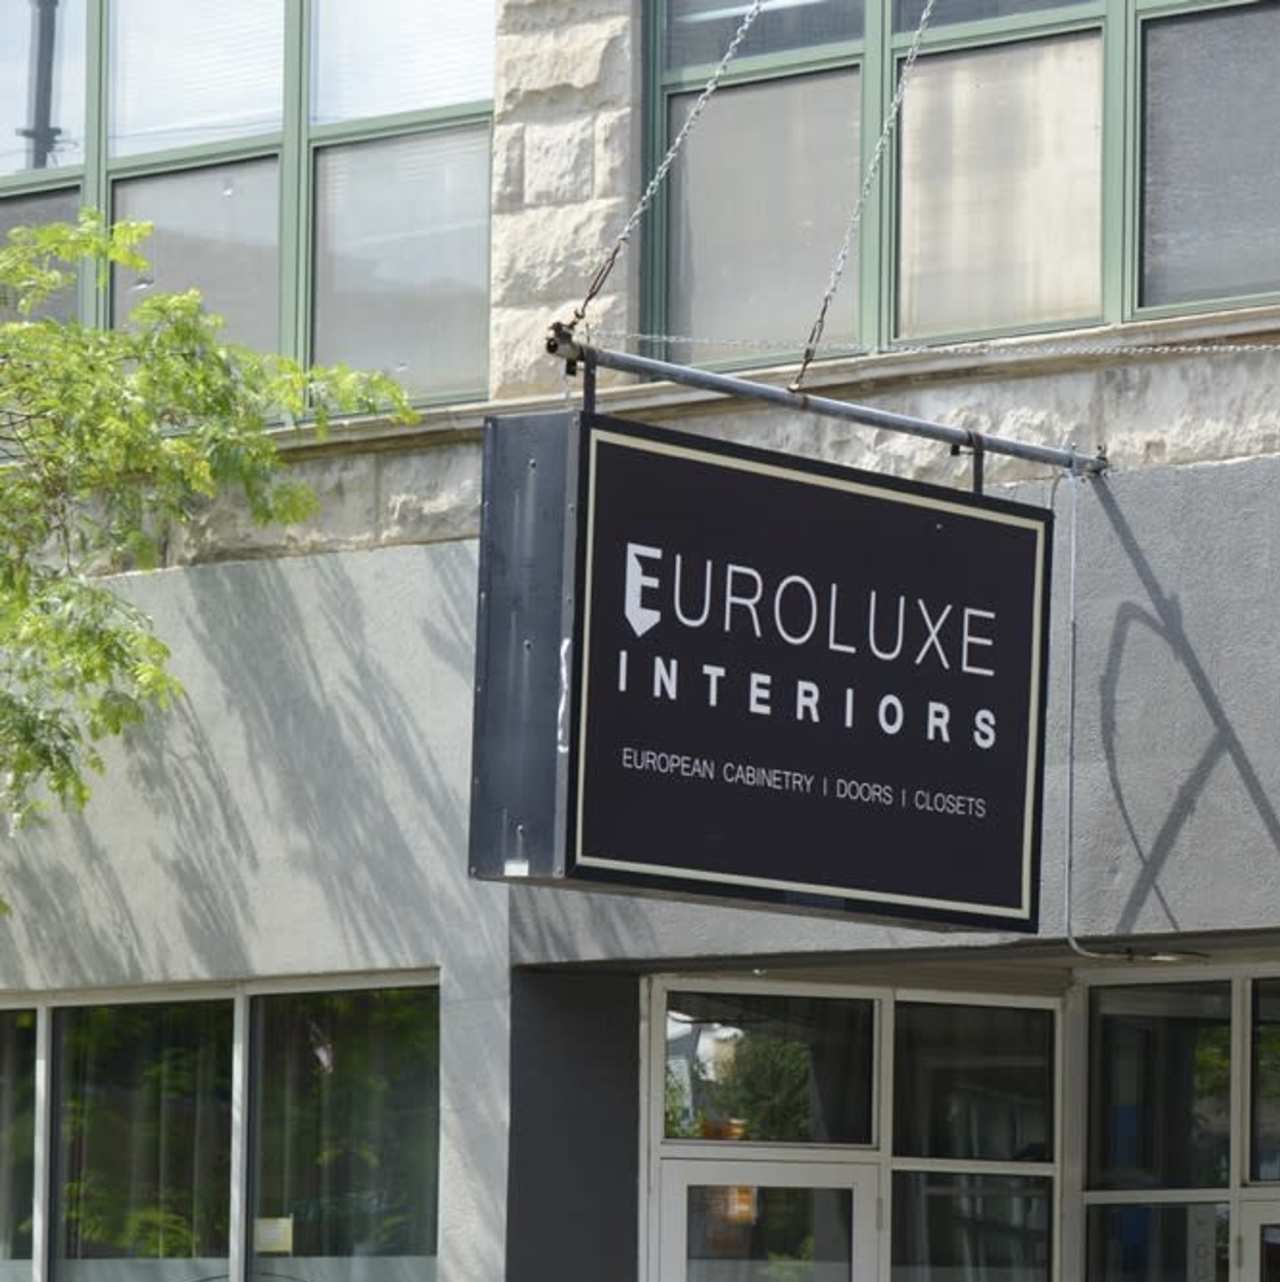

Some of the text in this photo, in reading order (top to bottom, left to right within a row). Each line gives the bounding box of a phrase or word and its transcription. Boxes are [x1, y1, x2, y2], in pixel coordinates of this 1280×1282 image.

[624, 542, 996, 677] EUROLUXE
[618, 650, 996, 748] INTERIORS
[622, 747, 987, 818] EUROPEAN CABINETRY DOORS CLOSETS
